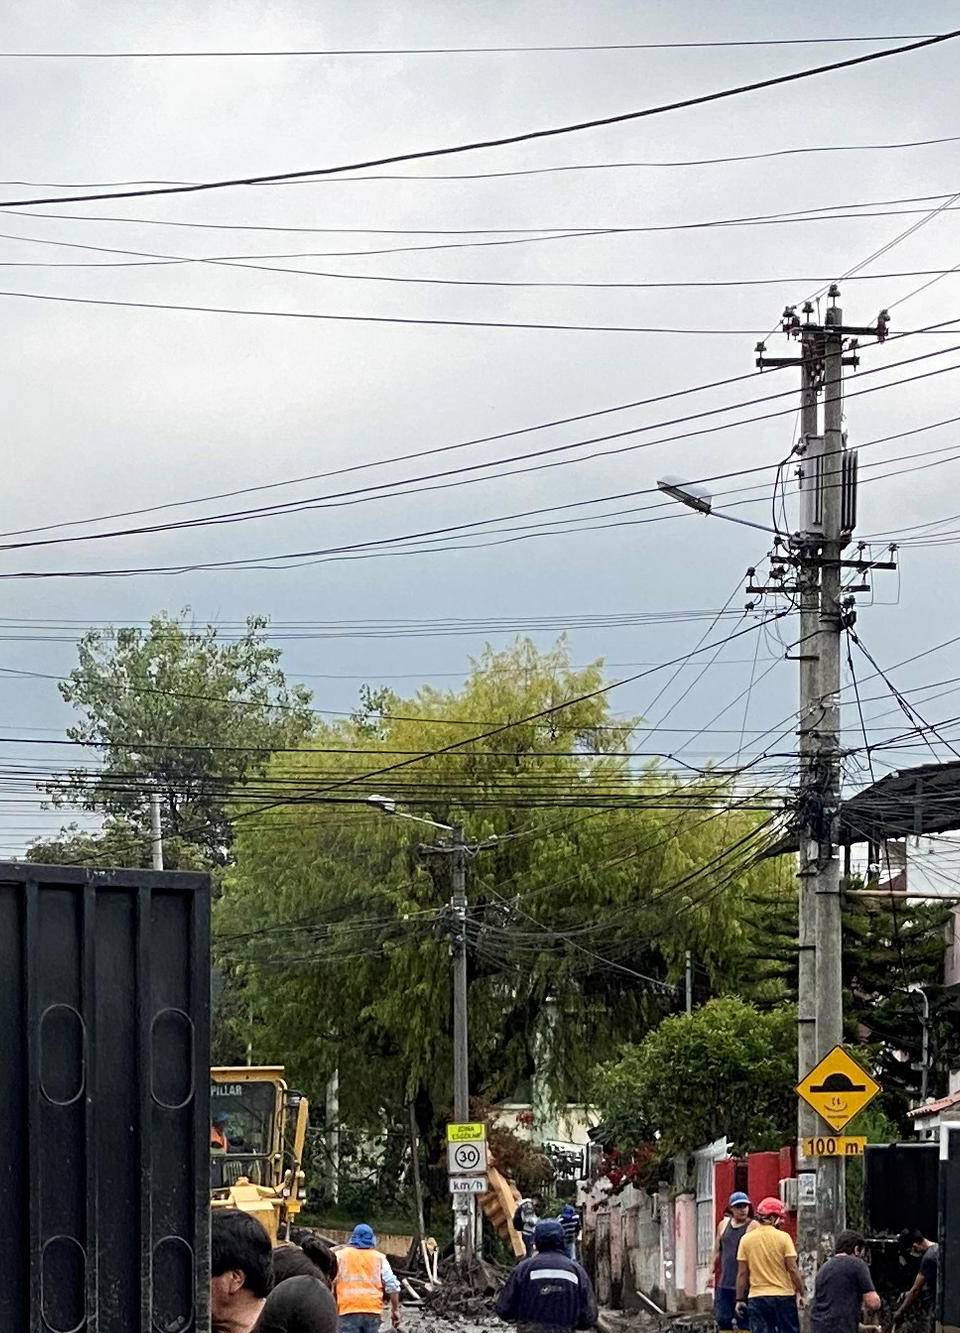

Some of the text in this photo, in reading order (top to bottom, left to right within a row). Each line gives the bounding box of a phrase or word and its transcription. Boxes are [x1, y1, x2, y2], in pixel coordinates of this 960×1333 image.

[807, 1138, 836, 1156] 100
[459, 1150, 476, 1162] 30
[453, 1180, 483, 1190] km/h
